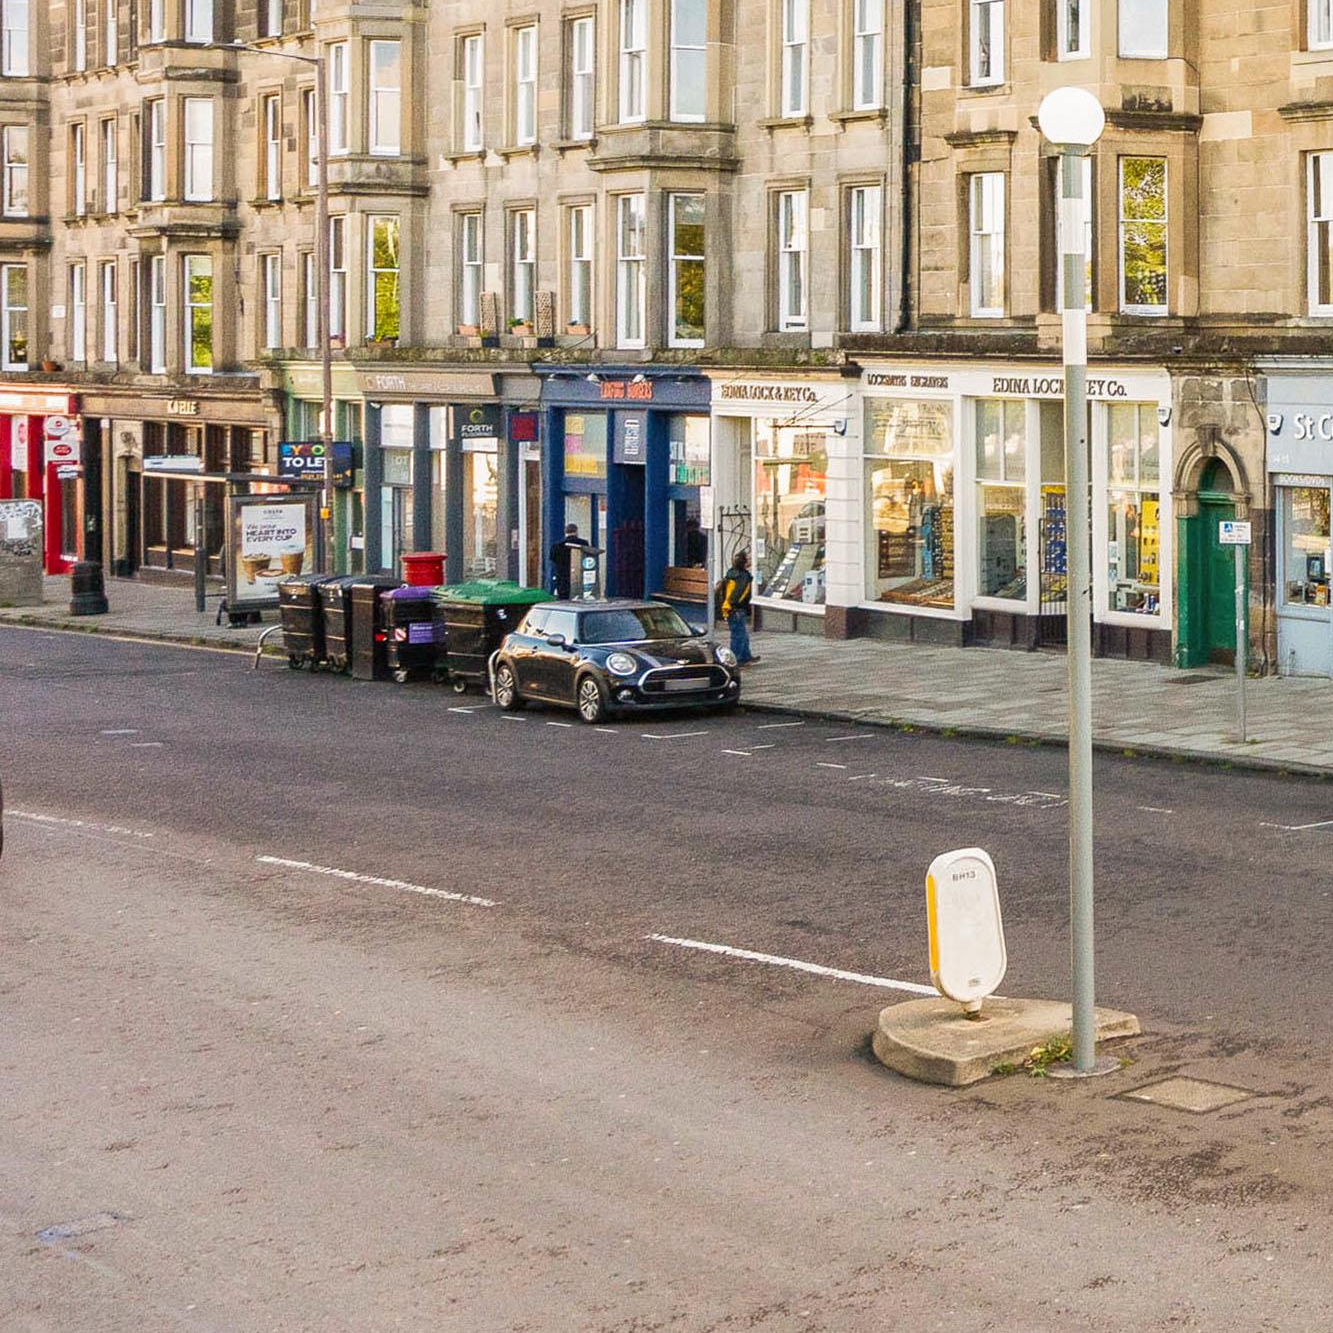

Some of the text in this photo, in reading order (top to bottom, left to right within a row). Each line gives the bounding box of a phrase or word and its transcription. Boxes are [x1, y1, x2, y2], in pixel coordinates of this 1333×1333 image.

[721, 384, 748, 400] EDINA
[750, 385, 773, 401] LOCK
[993, 377, 1031, 393] EDINA
[461, 424, 493, 433] FORTH
[1294, 413, 1315, 440] St
[283, 457, 304, 468] TO
